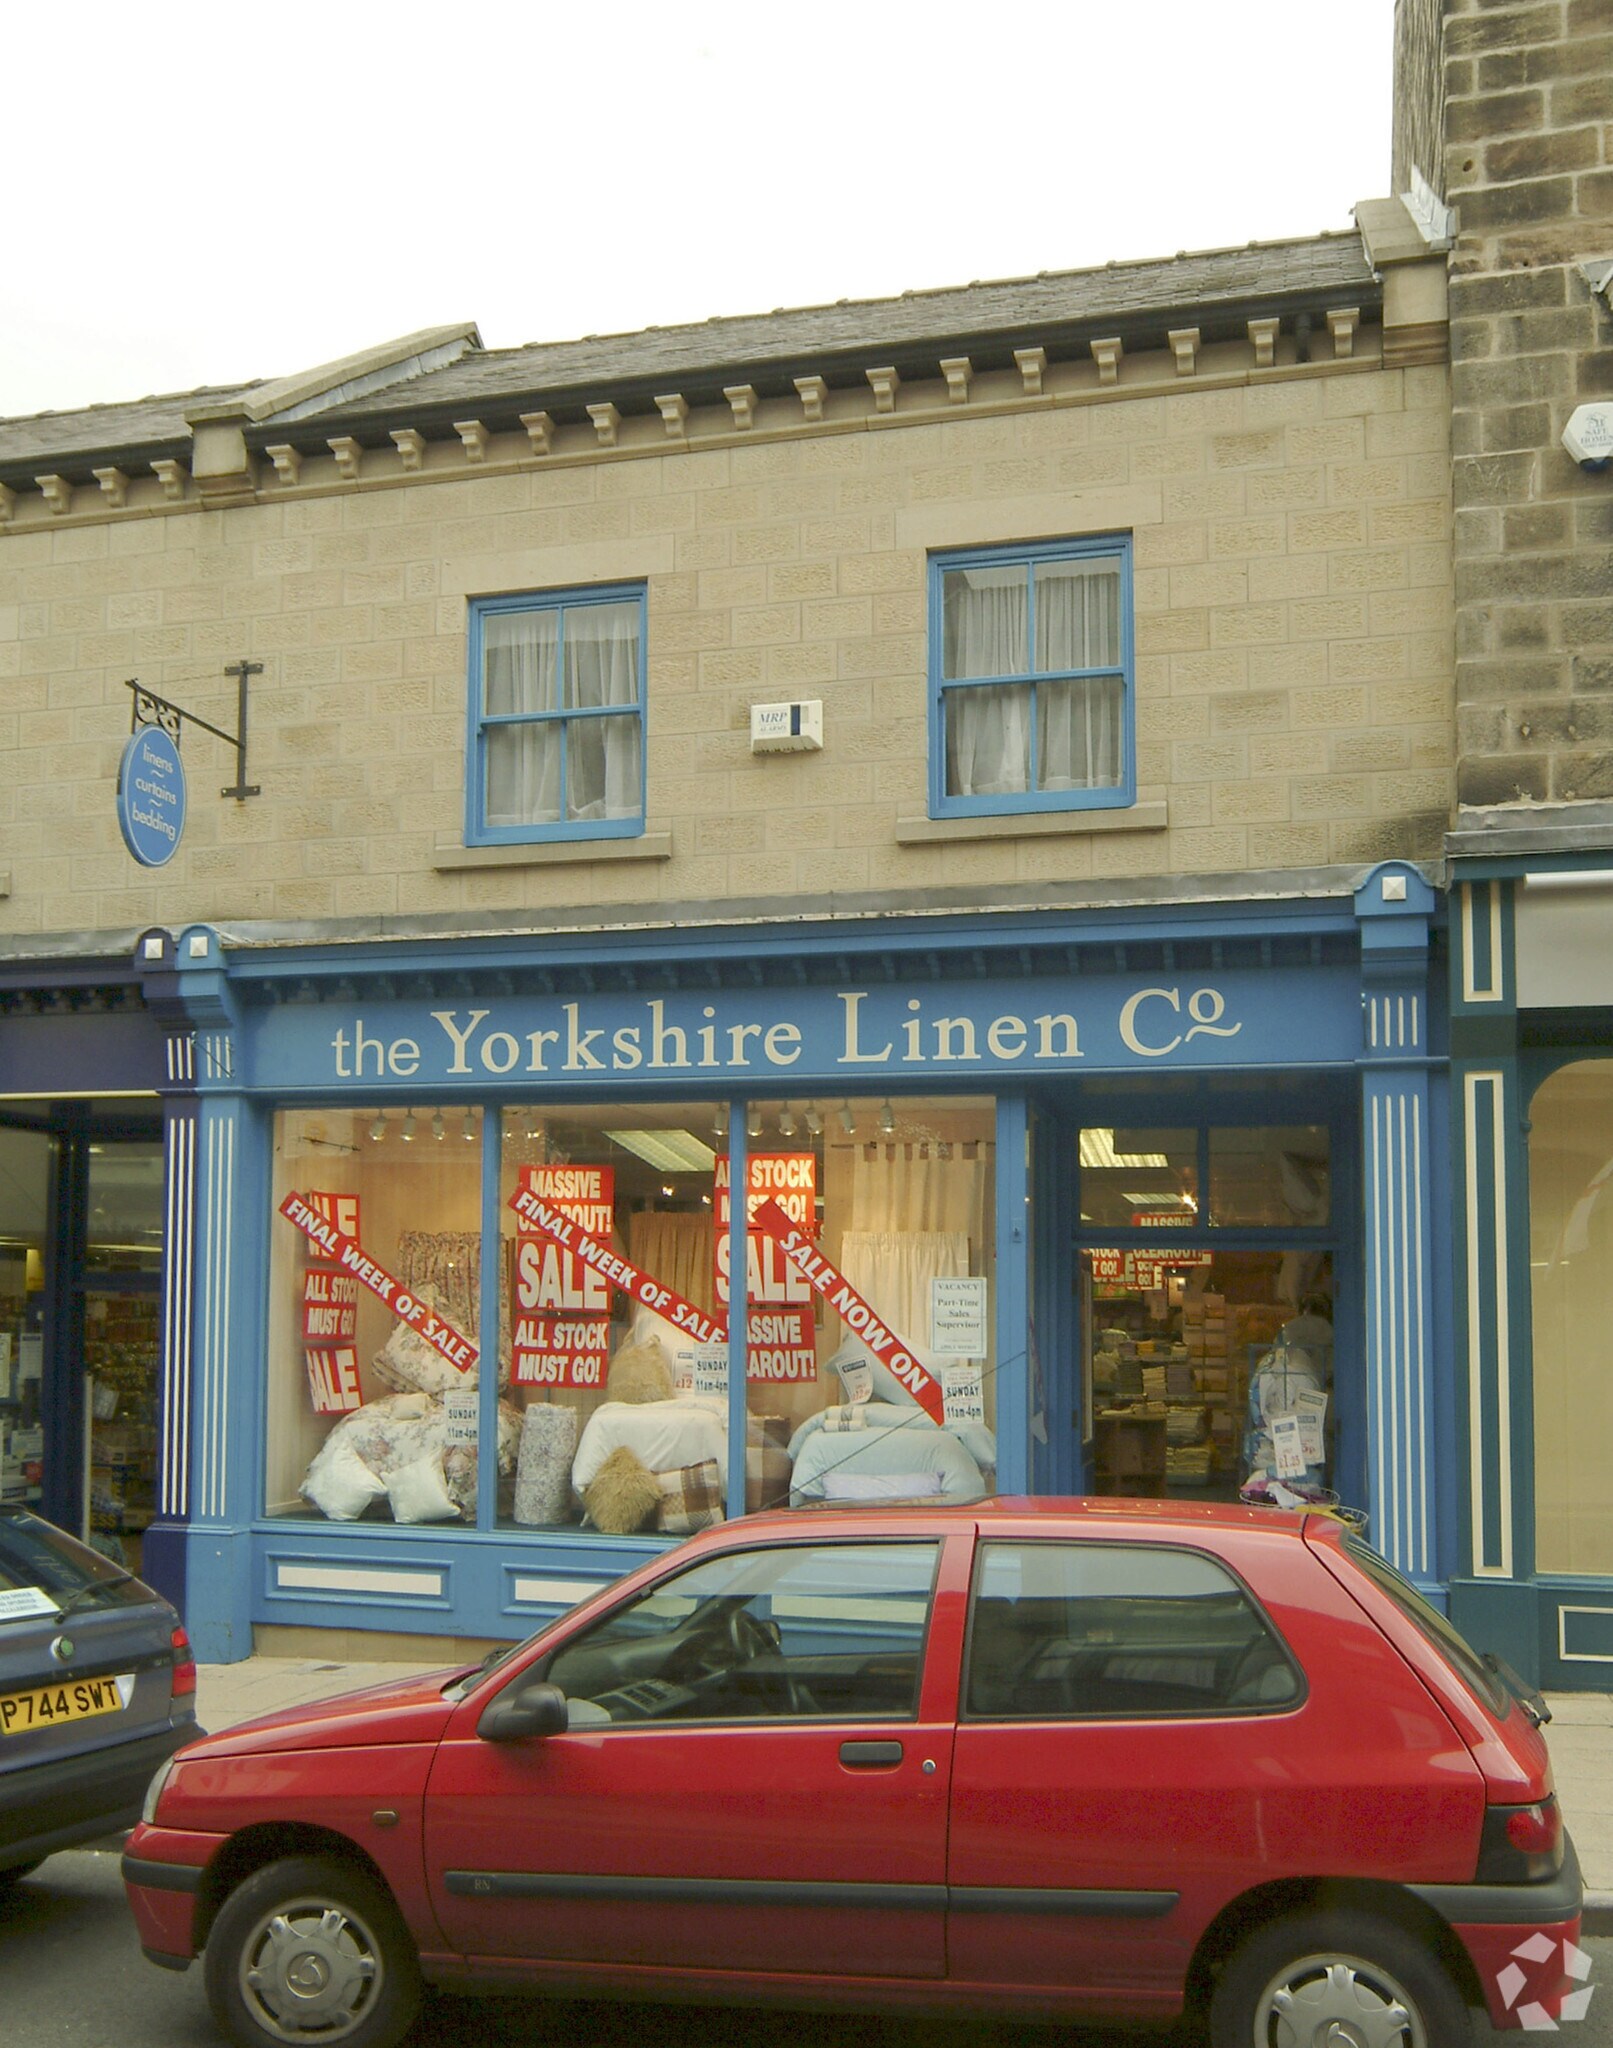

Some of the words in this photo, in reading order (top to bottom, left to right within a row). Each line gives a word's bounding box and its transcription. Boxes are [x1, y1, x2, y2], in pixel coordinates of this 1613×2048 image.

[143, 743, 174, 774] linens
[135, 778, 177, 805] curtains
[132, 801, 176, 841] bedding
[331, 1019, 420, 1078] the
[430, 999, 802, 1074] Yorkshire
[837, 992, 1085, 1063] Linen
[530, 1169, 601, 1199] MASSIVE
[751, 1158, 813, 1189] STOCK
[518, 1204, 612, 1233] CROUT!
[721, 1194, 770, 1223] MS
[515, 1191, 576, 1245] FINAL
[577, 1236, 637, 1289] WEEK
[639, 1282, 672, 1309] OF
[670, 1303, 726, 1343] SALE
[518, 1242, 608, 1309] SALE
[716, 1234, 811, 1302] SALE
[286, 1199, 339, 1252] FINAL
[340, 1245, 396, 1300] WEEK
[395, 1294, 426, 1321] OF
[421, 1317, 471, 1366] SALE
[305, 1274, 329, 1301] ALL
[938, 1283, 979, 1291] VACANCY
[779, 1230, 837, 1292] SALE
[830, 1286, 894, 1352] NOW
[889, 1352, 930, 1395] ON
[937, 1298, 979, 1307] Part-Time
[307, 1307, 340, 1335] MUST
[514, 1319, 548, 1348] ALL
[553, 1322, 608, 1350] STOCK
[745, 1314, 802, 1344] SSIVE
[936, 1321, 981, 1331] Supervisor
[518, 1353, 569, 1382] MUST
[571, 1356, 600, 1384] GO!
[696, 1360, 728, 1372] SUNDAY
[746, 1349, 816, 1379] AROUT!
[695, 1379, 729, 1394] 11am-4pm
[946, 1386, 979, 1397] SUNDAY
[448, 1408, 477, 1419] SUNDAY
[946, 1404, 982, 1420] 11am-4pm
[447, 1427, 478, 1441] 11am-4pm
[1, 1689, 70, 1729] P744
[73, 1680, 116, 1713] SWT
